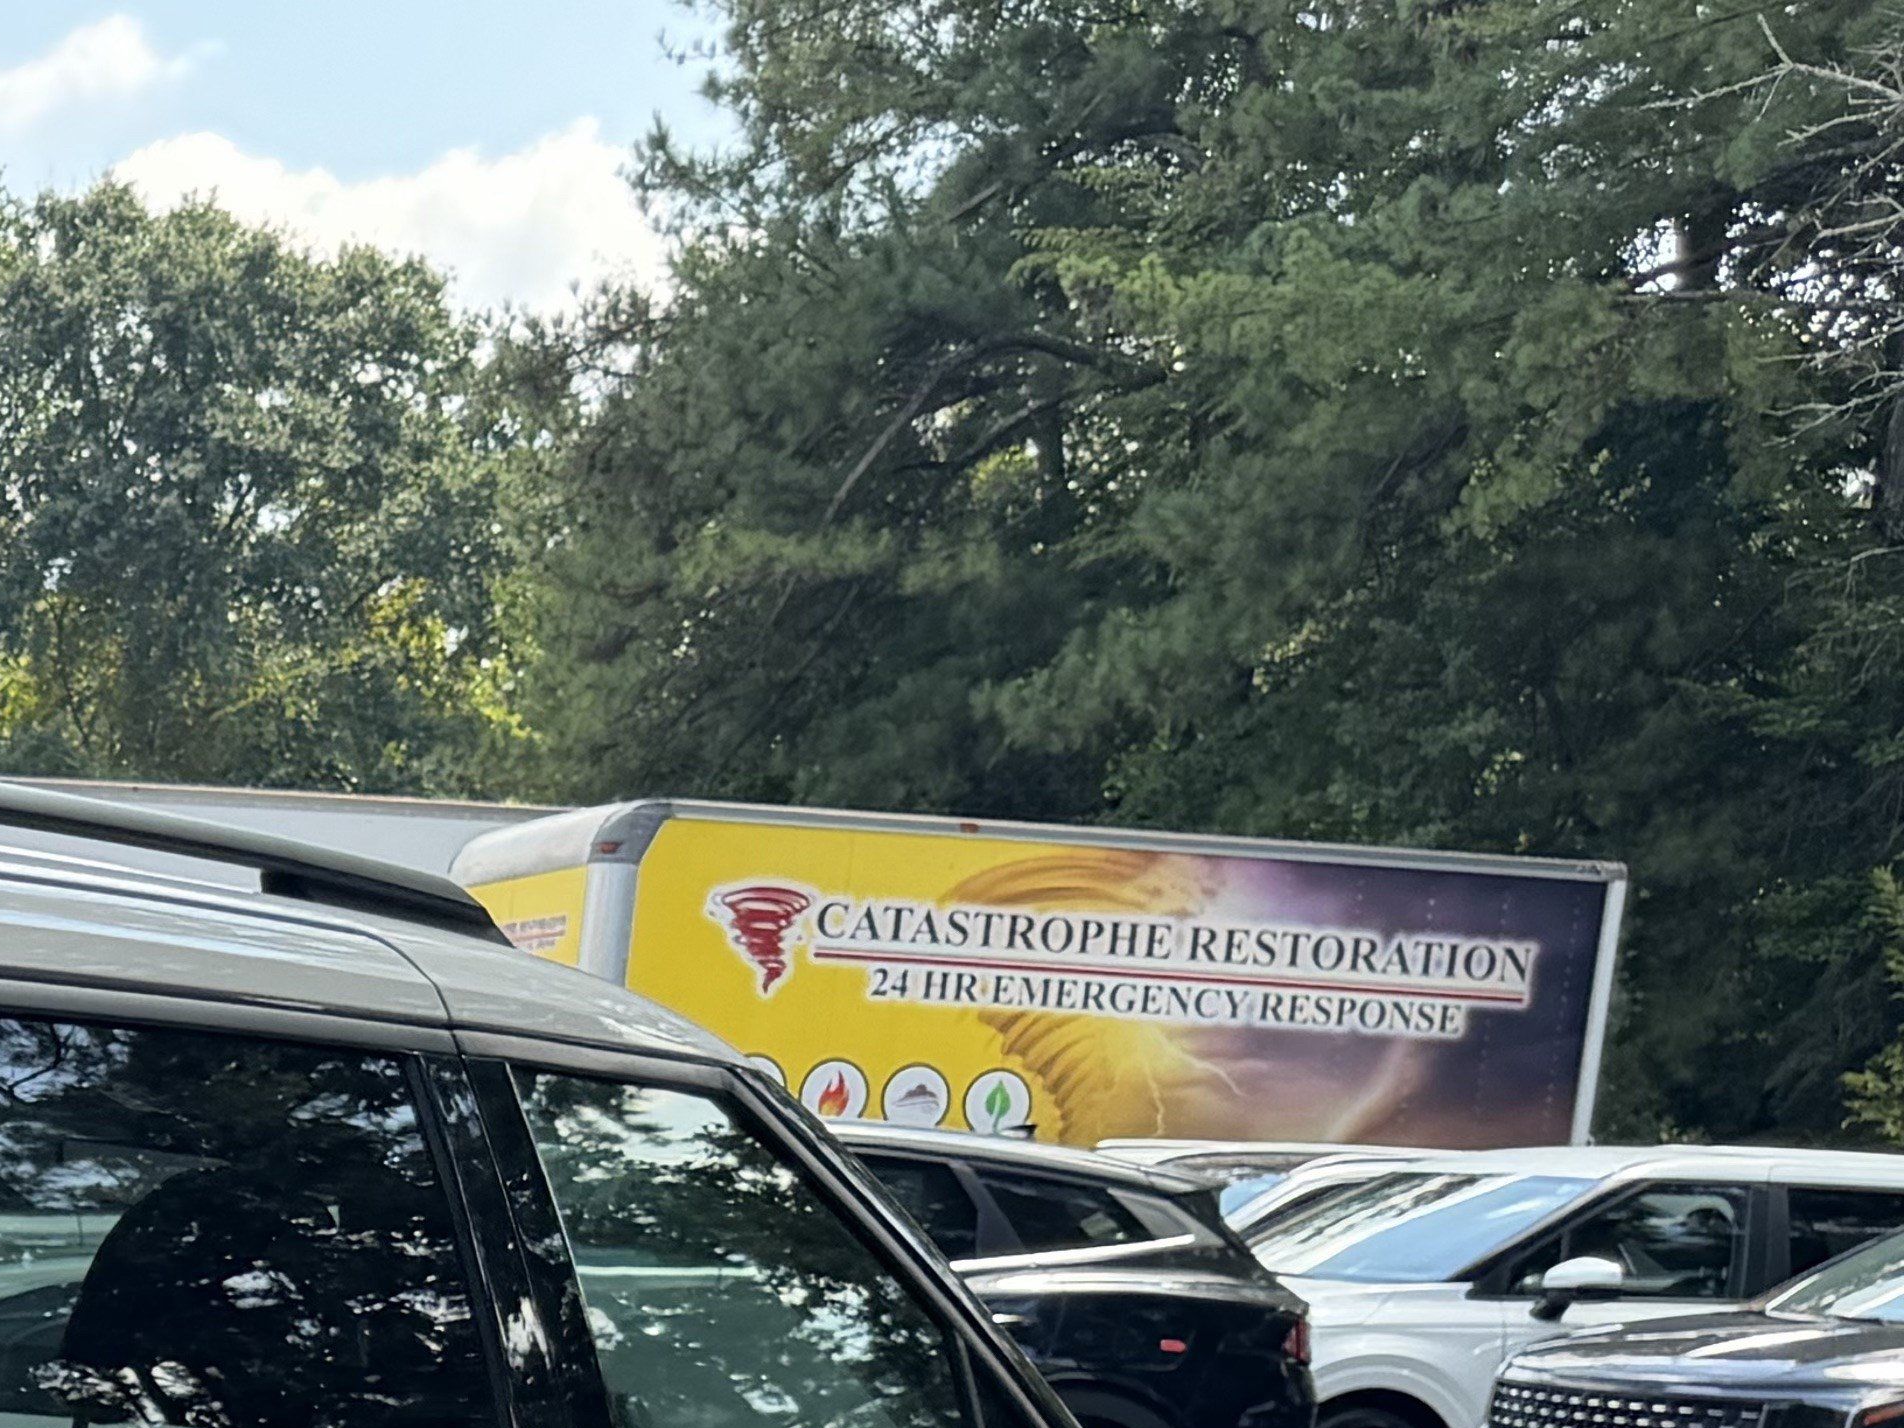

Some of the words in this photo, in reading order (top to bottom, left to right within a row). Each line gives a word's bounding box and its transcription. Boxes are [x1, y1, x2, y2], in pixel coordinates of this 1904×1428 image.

[816, 901, 1173, 960] CATASTROPHE
[1187, 926, 1531, 984] RESTORATION
[870, 968, 909, 998] 24
[923, 970, 978, 1002] HR
[993, 974, 1250, 1020] EMERGENCY
[1258, 991, 1463, 1035] RESPONSE
